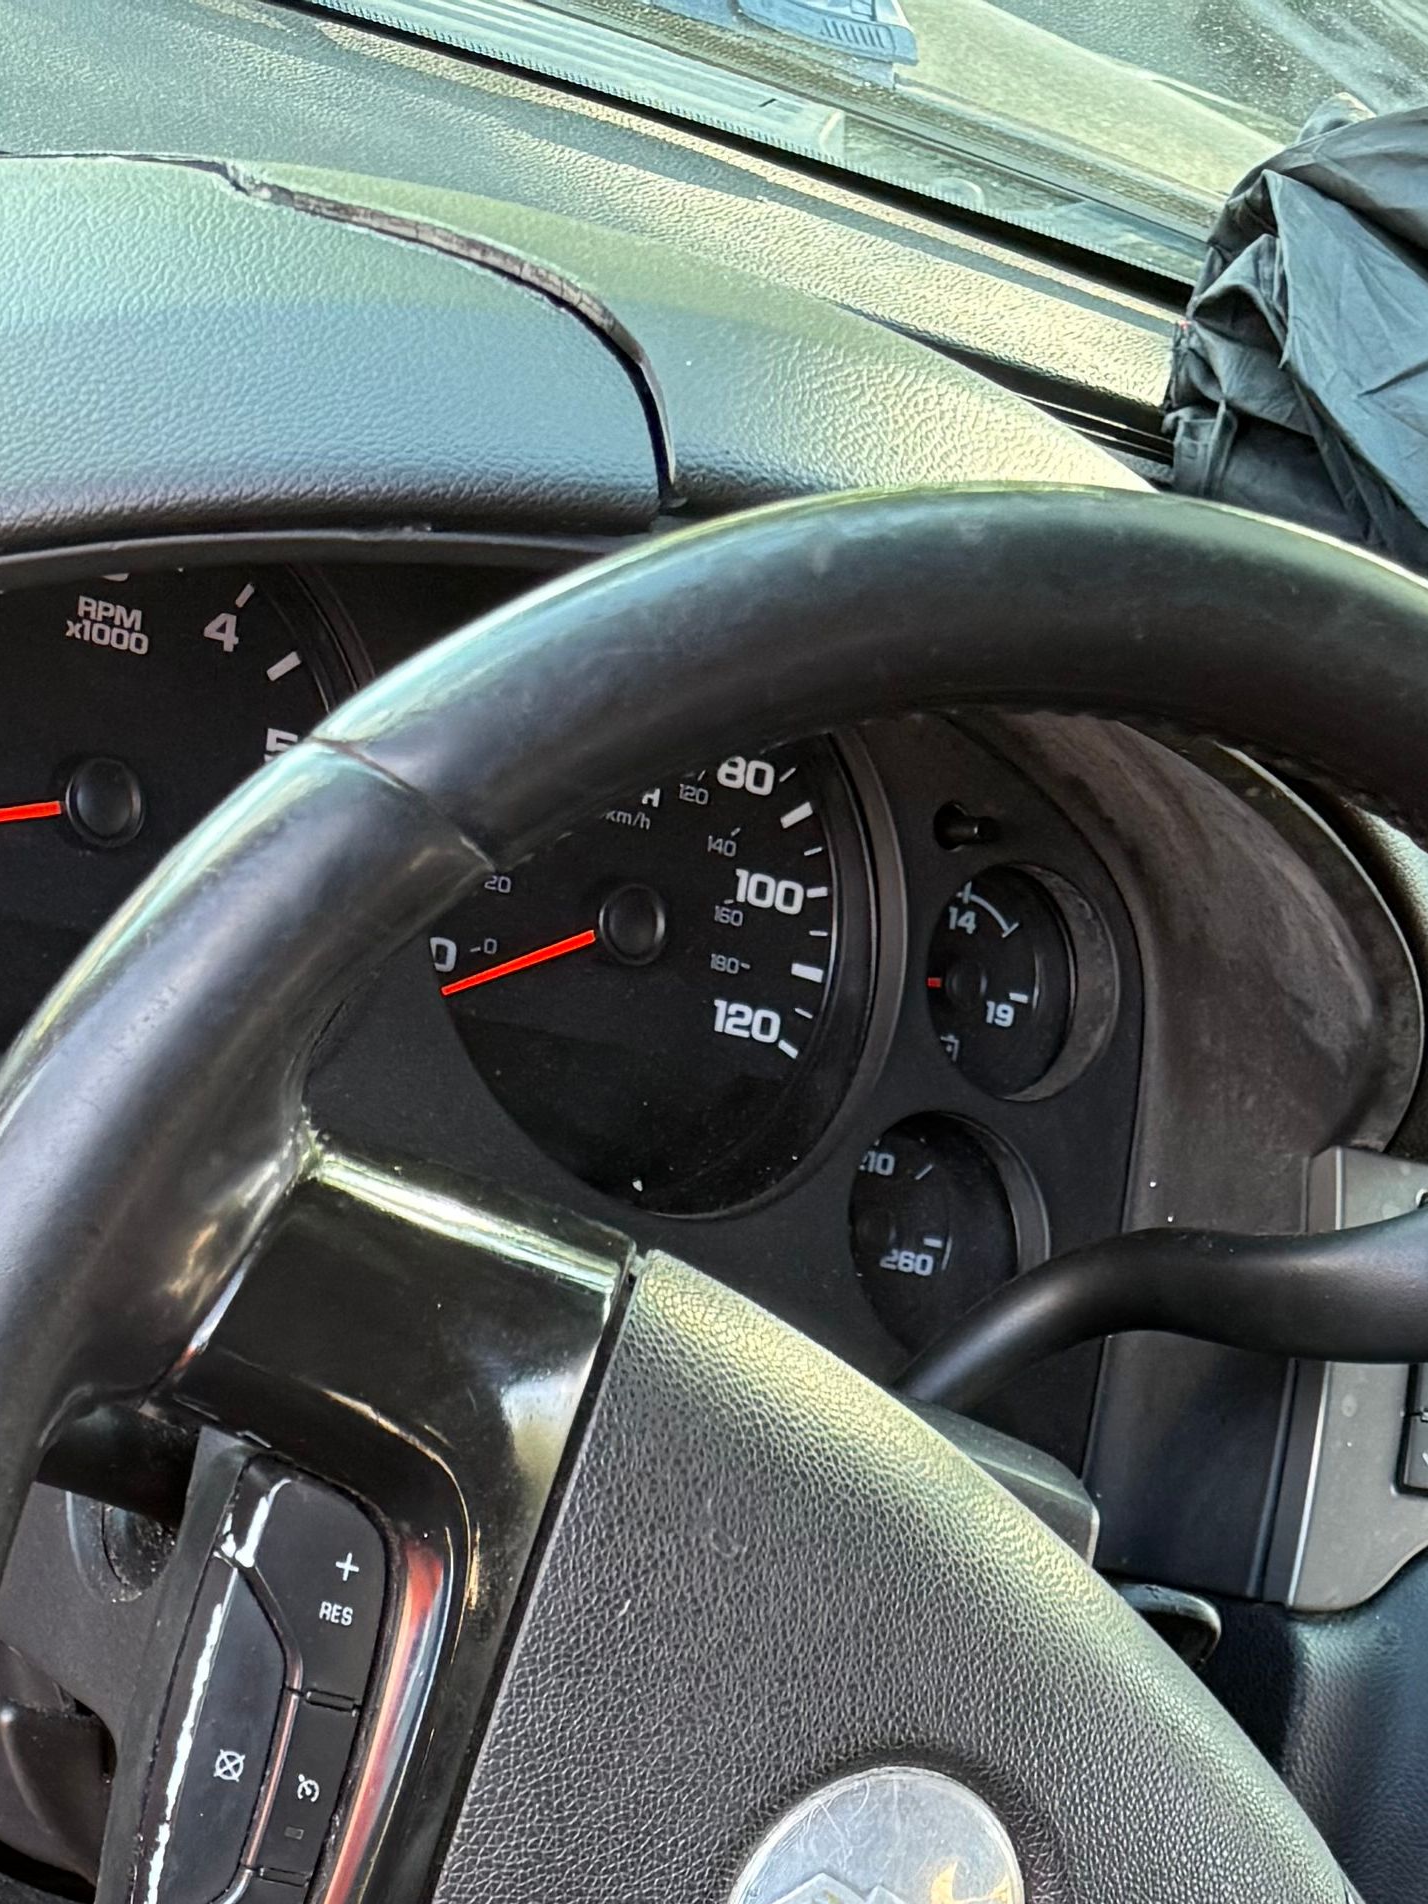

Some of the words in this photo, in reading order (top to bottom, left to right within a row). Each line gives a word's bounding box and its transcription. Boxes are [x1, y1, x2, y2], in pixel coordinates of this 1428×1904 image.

[78, 595, 142, 631] RPM
[65, 619, 149, 655] x1000
[203, 612, 239, 652] 4
[717, 756, 775, 796] 80
[679, 783, 709, 805] 120
[707, 835, 737, 857] 140
[484, 875, 512, 893] 20
[734, 868, 804, 915] 100
[714, 904, 743, 927] 160
[948, 906, 976, 934] 14
[710, 952, 739, 975] 180
[713, 999, 781, 1043] 120
[985, 1000, 1014, 1028] 19
[879, 1248, 934, 1276] 260
[319, 1601, 352, 1627] RES
